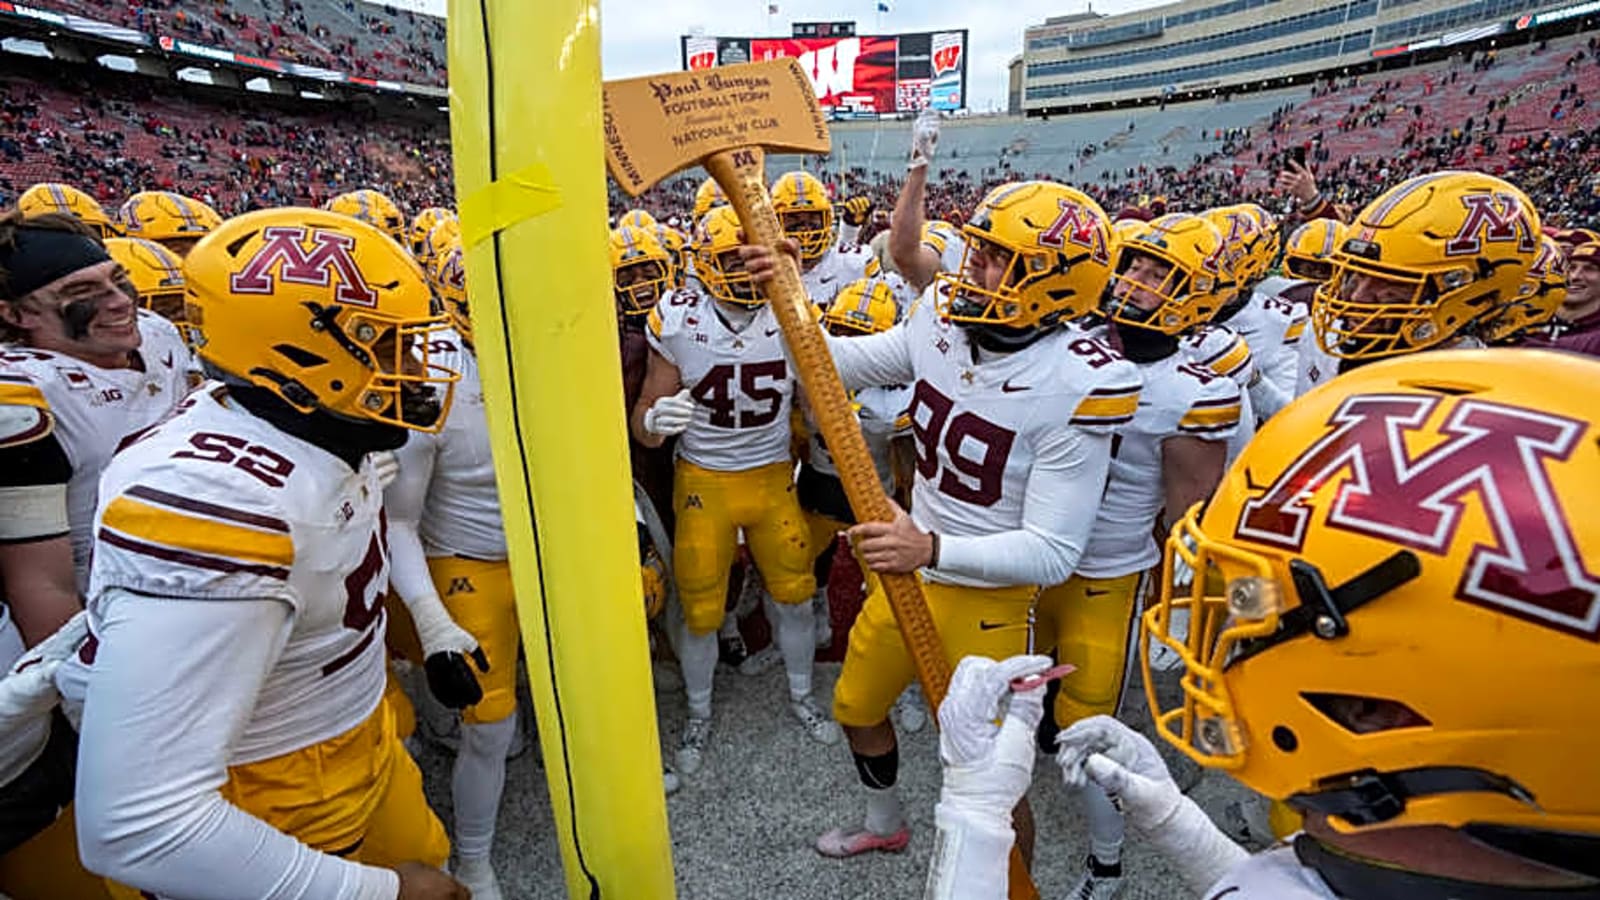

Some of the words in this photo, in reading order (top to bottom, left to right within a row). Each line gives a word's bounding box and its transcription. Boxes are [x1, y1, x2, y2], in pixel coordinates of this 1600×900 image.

[933, 46, 961, 73] W
[648, 78, 702, 103] Paul
[664, 97, 731, 117] FOOTBALL
[730, 91, 770, 103] TROPHY
[672, 125, 733, 146] NATIONAL
[731, 150, 758, 169] M
[1038, 198, 1110, 266] M
[1445, 194, 1538, 255] M
[229, 226, 379, 309] M
[691, 360, 787, 429] 45
[169, 432, 295, 488] 52
[908, 378, 1017, 507] 99
[1234, 393, 1600, 644] M
